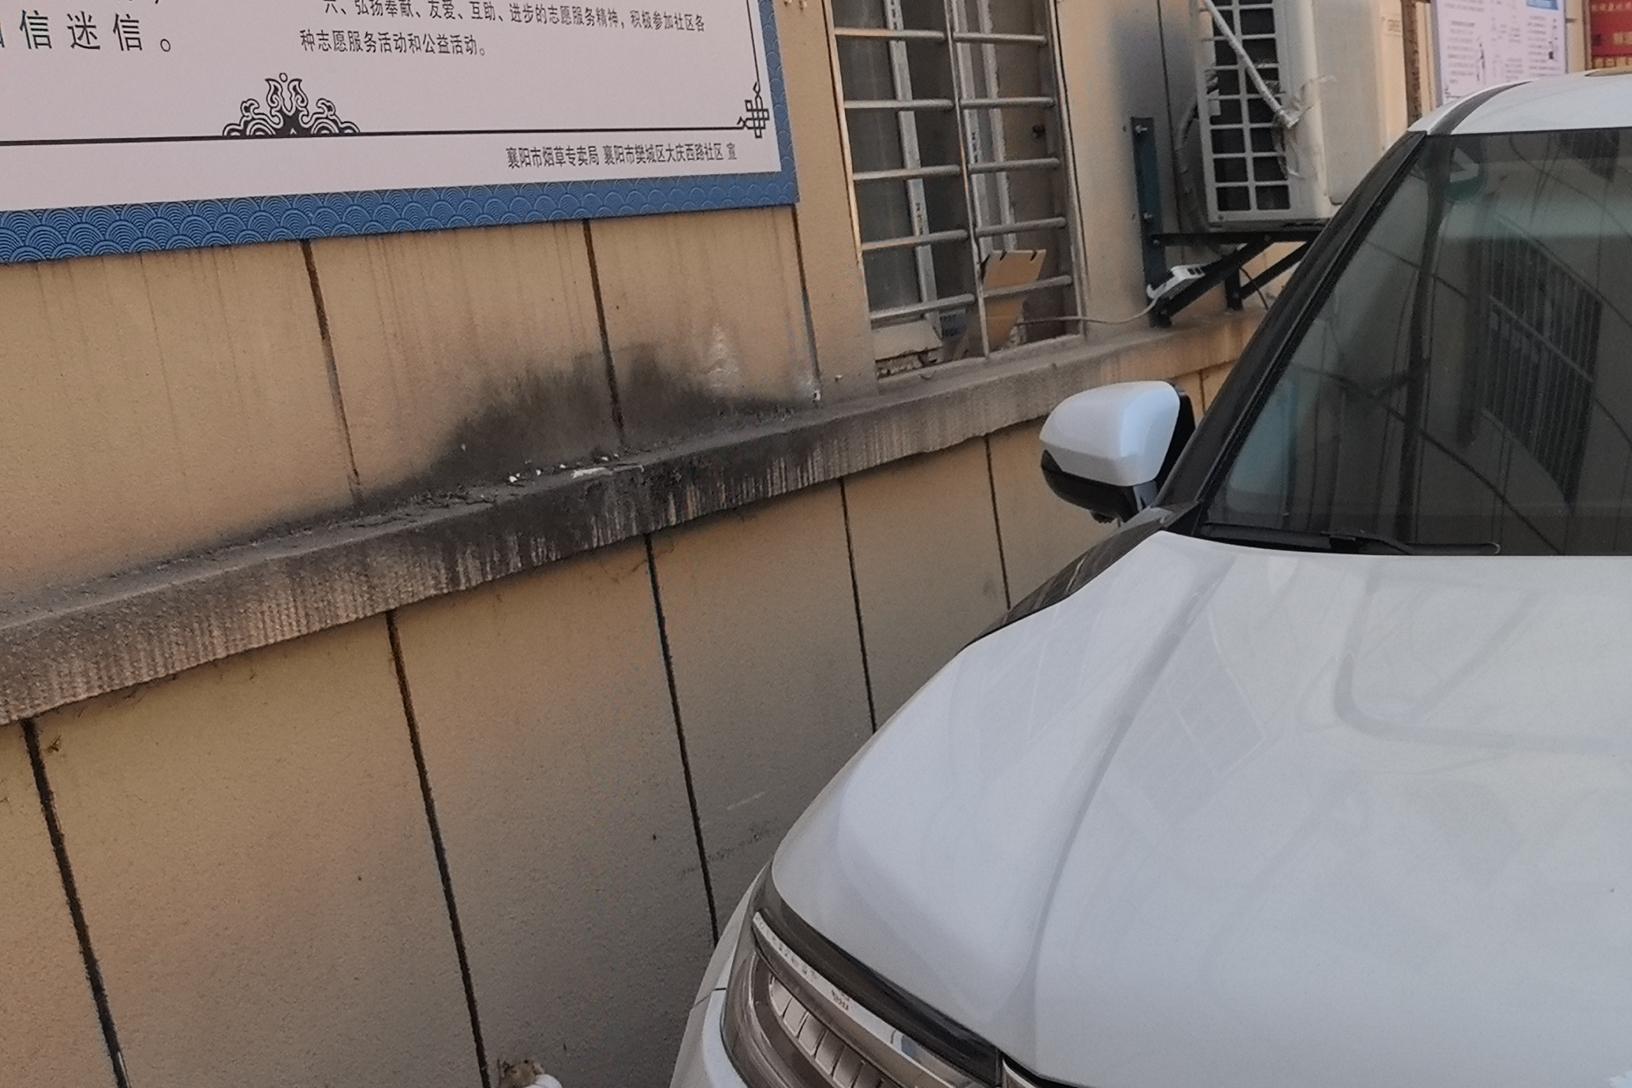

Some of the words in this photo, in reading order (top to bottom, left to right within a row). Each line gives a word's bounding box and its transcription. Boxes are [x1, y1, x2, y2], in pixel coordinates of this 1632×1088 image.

[0, 10, 171, 52] 信迷信。
[299, 28, 486, 56] 种志愿服务活动和公益活动。
[505, 146, 600, 169] 襄阳市烟草专卖局
[602, 142, 724, 165] 襄阳市樊城区大庆西路社区
